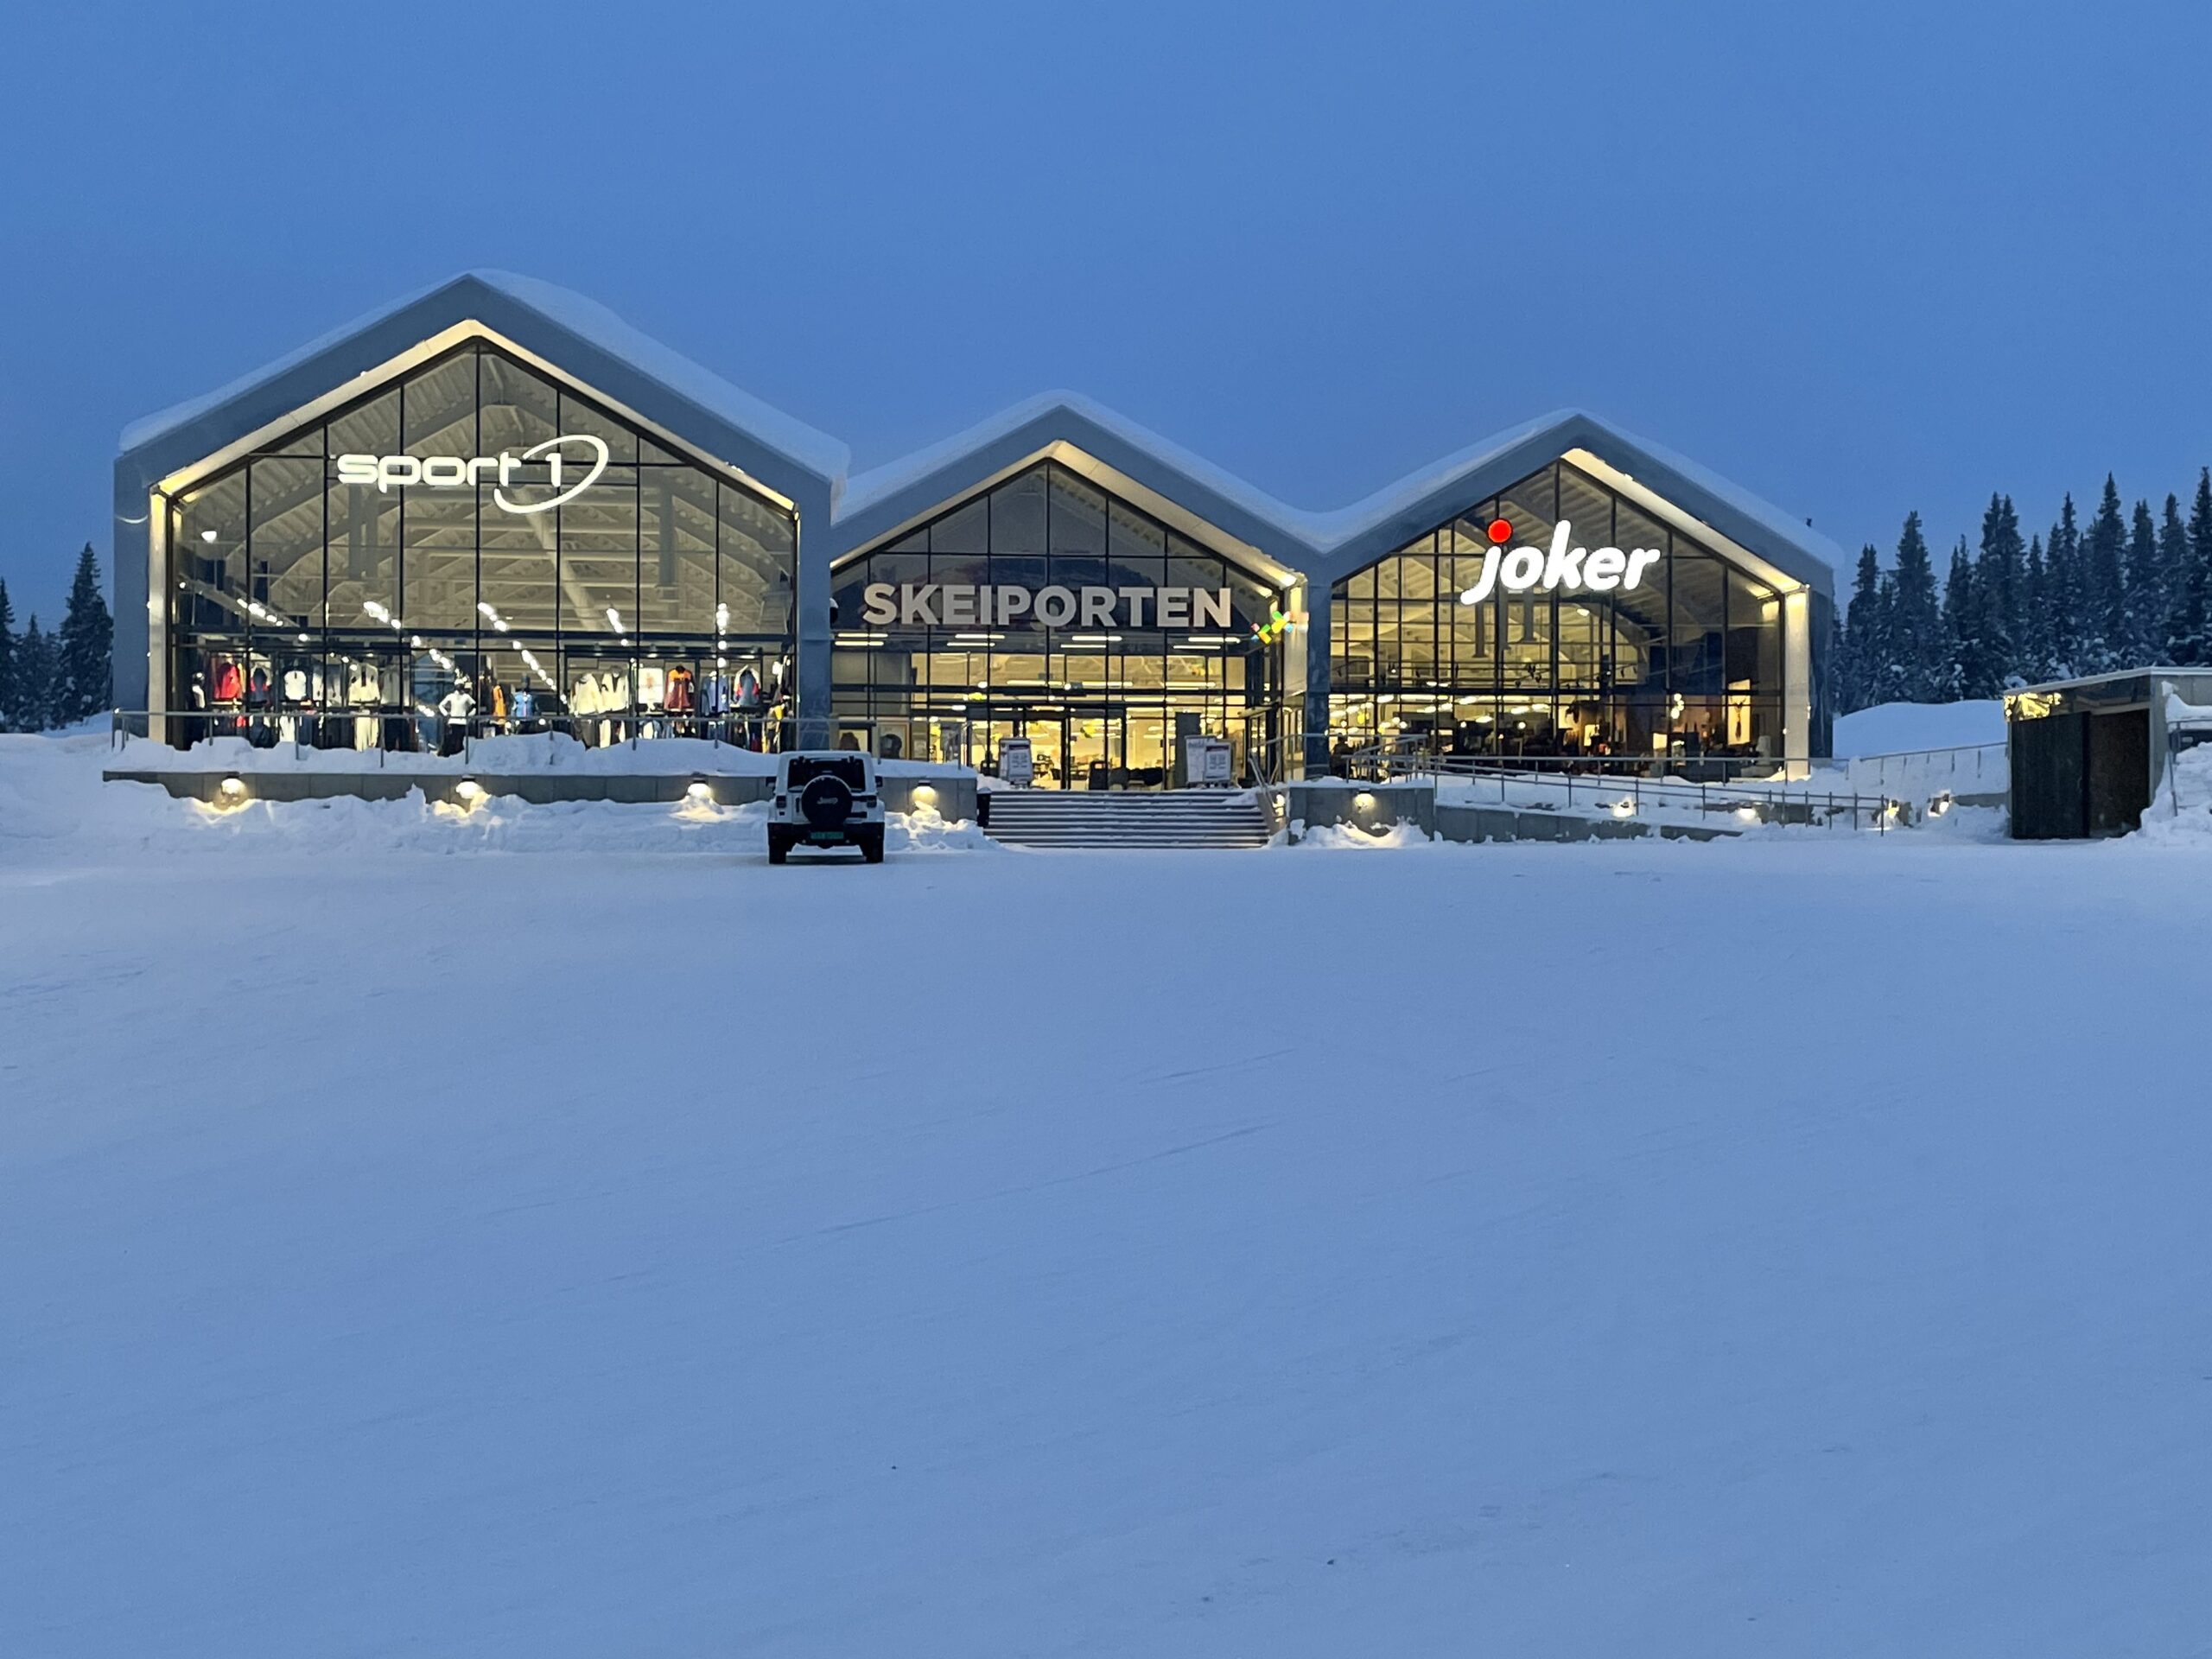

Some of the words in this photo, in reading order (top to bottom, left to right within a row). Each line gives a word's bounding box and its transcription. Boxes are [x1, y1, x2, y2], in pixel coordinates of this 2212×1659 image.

[337, 452, 522, 493] sport
[1460, 519, 1661, 605] joker
[862, 582, 1231, 628] SKEIPORTEN
